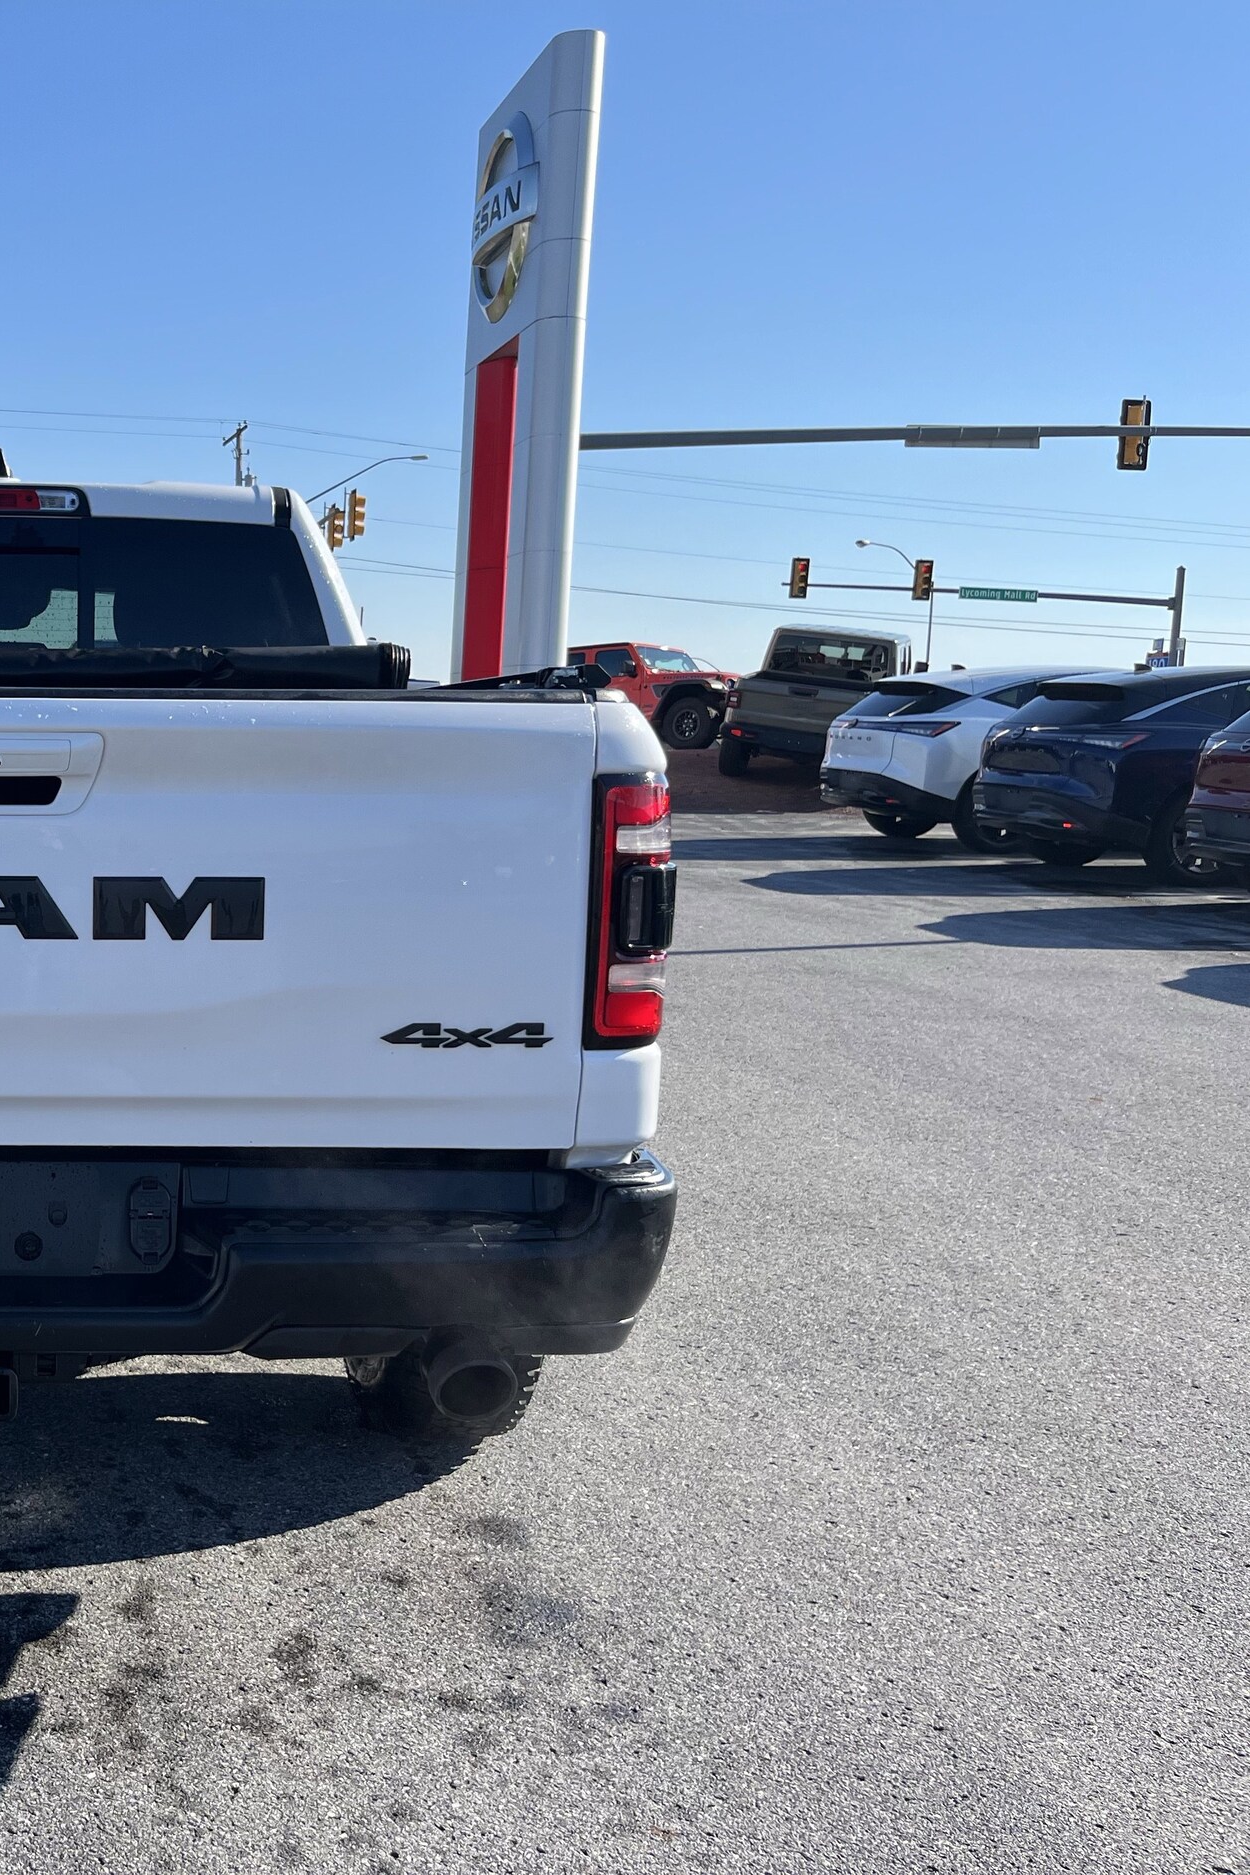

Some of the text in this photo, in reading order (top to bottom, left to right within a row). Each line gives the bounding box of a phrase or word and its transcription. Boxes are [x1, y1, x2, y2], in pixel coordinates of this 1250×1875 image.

[474, 180, 522, 243] SSAN
[961, 588, 1036, 601] Lycoming Mall Rd
